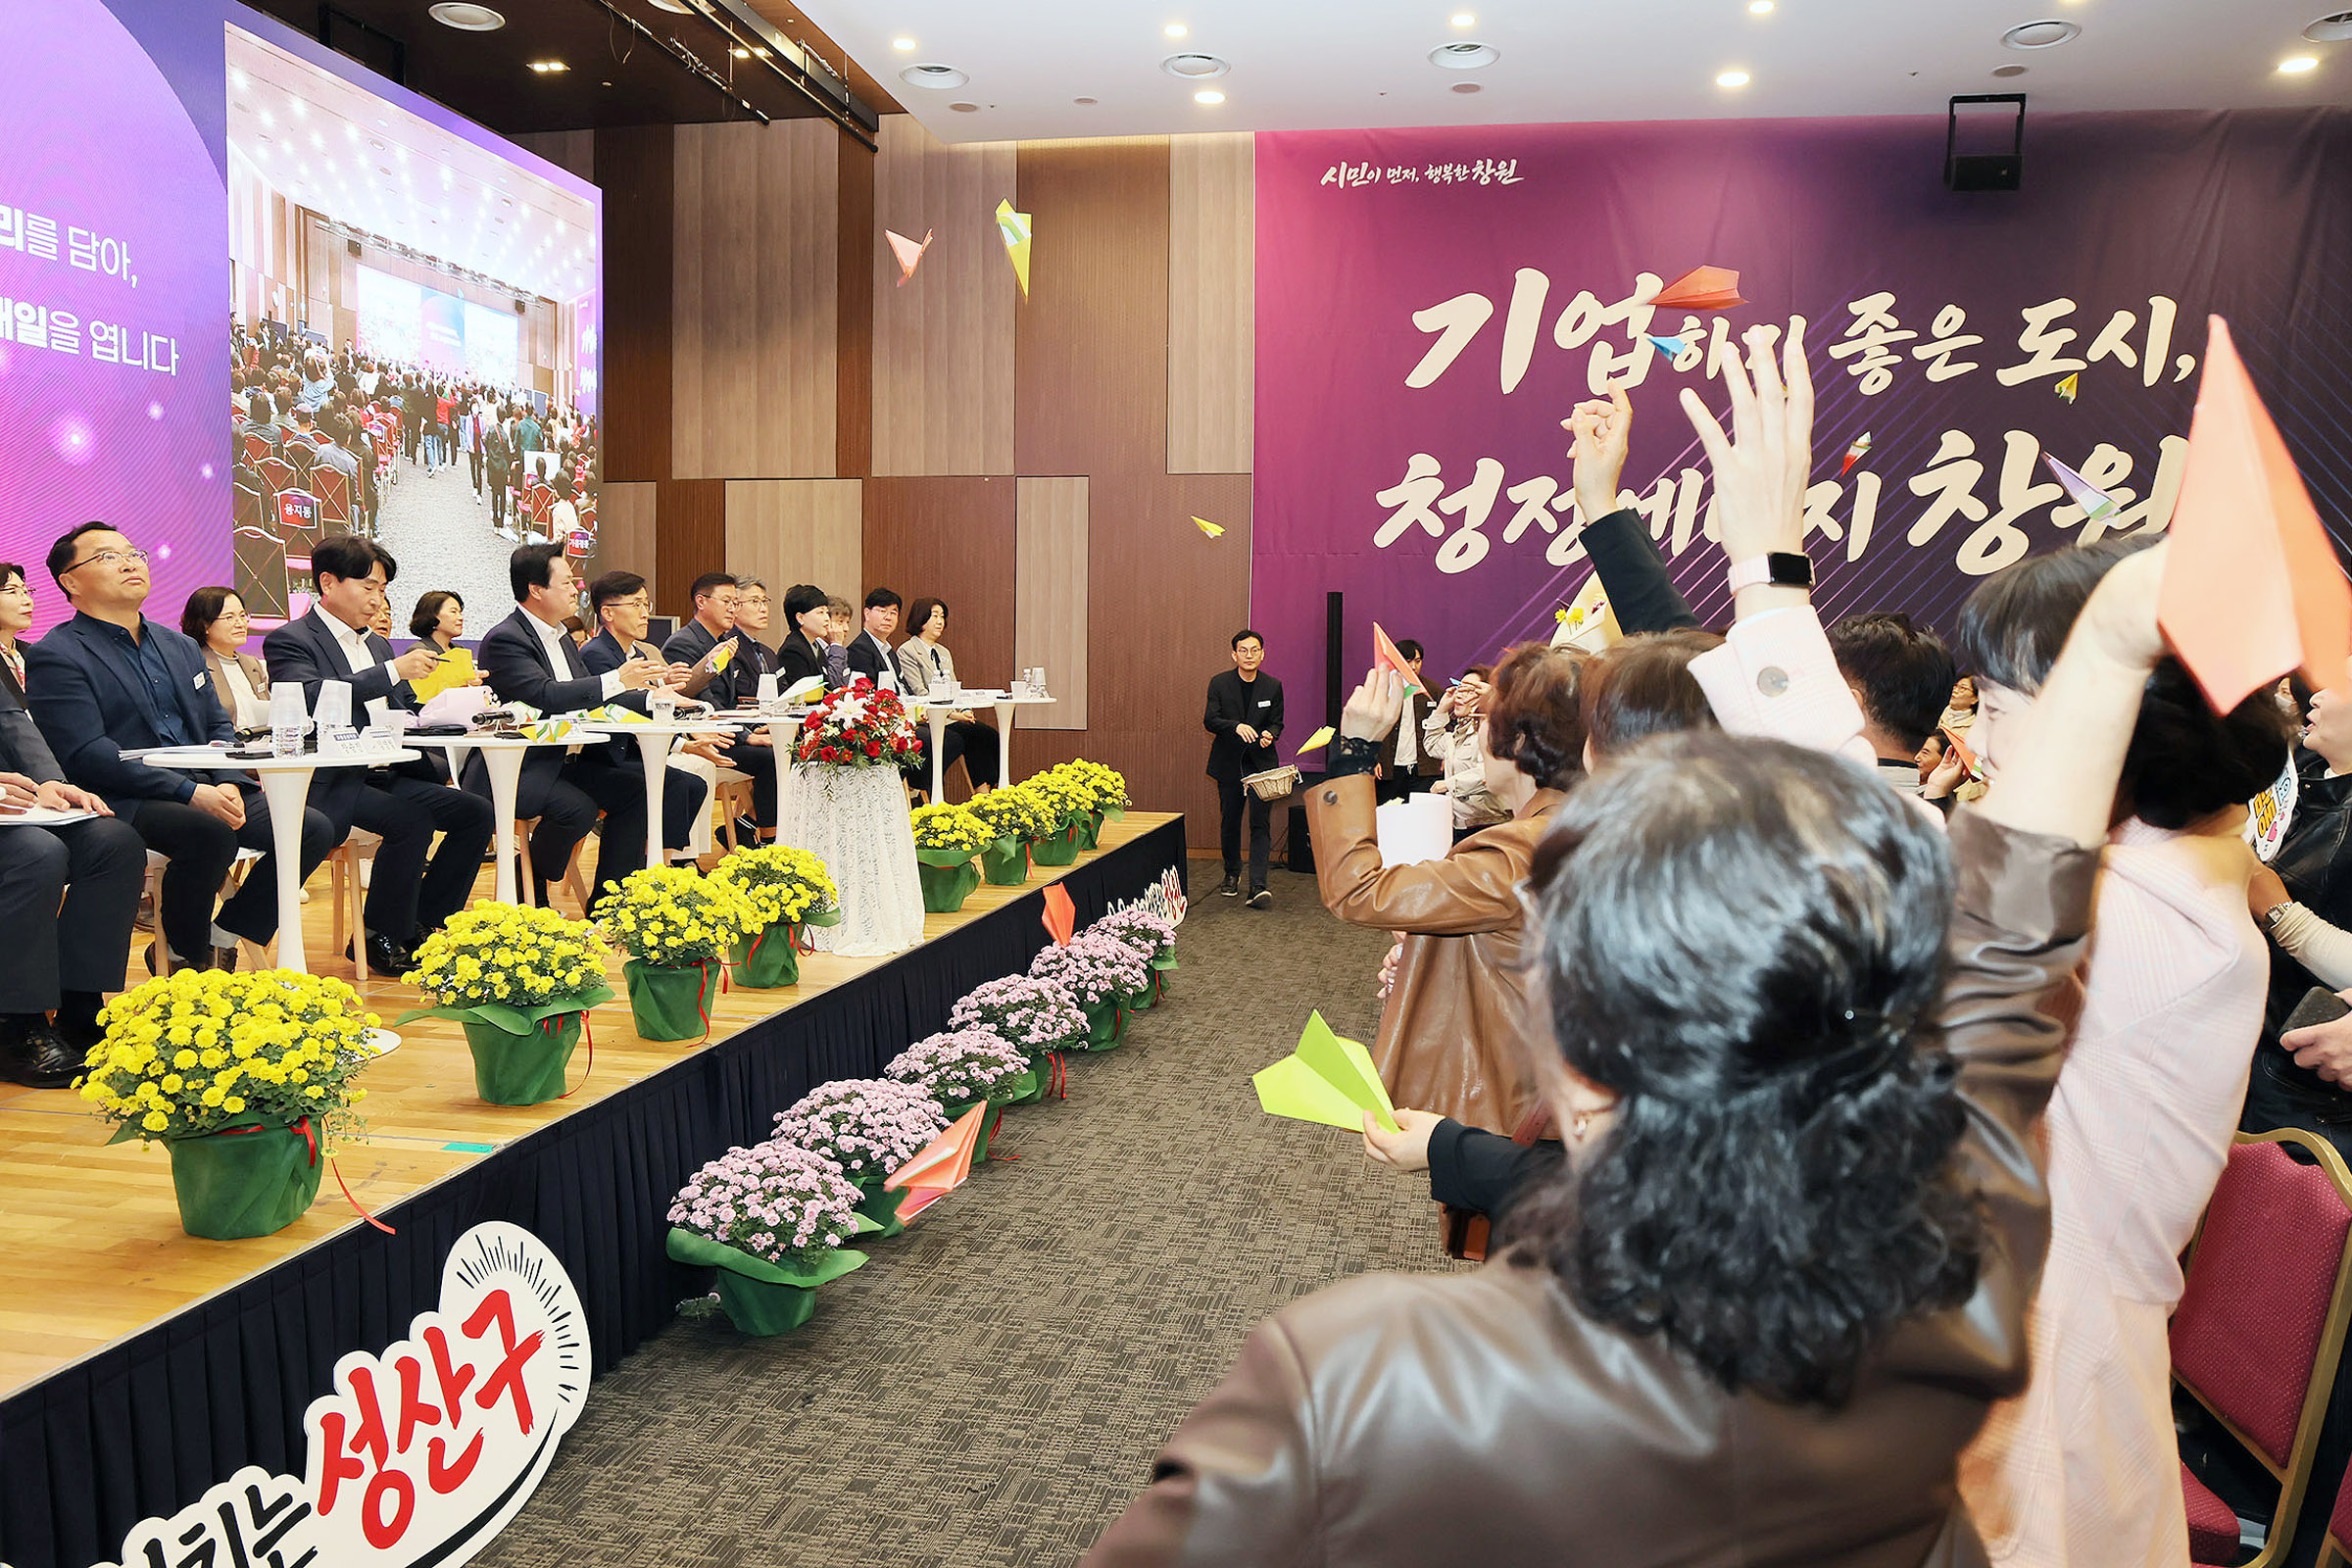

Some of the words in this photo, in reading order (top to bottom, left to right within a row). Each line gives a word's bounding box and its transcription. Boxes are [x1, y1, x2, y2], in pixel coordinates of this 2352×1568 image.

[1320, 161, 1381, 189] 시민이
[1386, 165, 1420, 185] 먼저,
[1424, 163, 1470, 185] 행복한
[1471, 158, 1525, 186] 창원
[68, 225, 138, 288] 담아,
[89, 320, 180, 376] 엽니다
[1829, 291, 1984, 395] 좋은
[1995, 295, 2196, 388] 도시,
[284, 503, 313, 519] 용지동
[1373, 453, 1882, 574] 청정에지
[318, 1289, 546, 1550] 성산구
